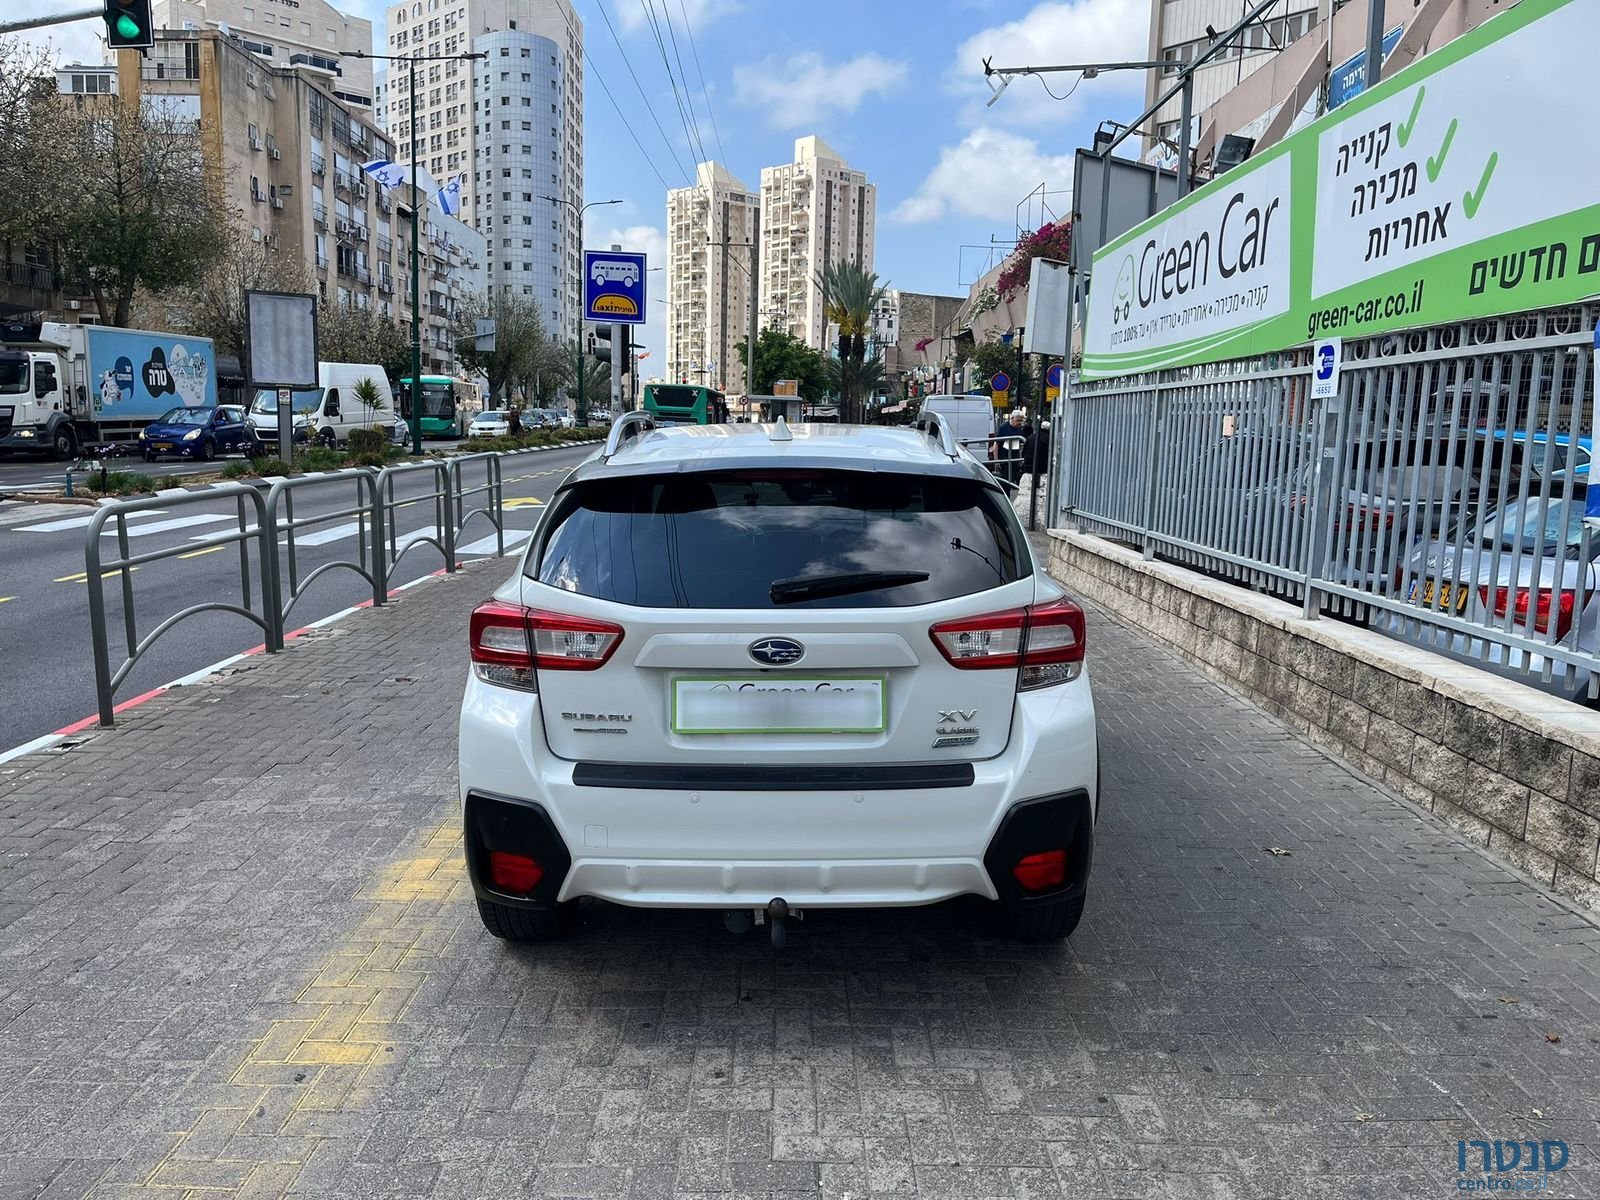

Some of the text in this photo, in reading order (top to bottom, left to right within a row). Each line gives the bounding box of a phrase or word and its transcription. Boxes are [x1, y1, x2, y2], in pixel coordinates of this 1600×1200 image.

[1336, 122, 1392, 177] קנייה
[1351, 162, 1417, 217] מכירה
[1365, 202, 1452, 262] אחריות
[1138, 192, 1279, 308] Green Car
[1468, 242, 1567, 296] חדשים
[1214, 294, 1239, 317] מכירה
[1247, 285, 1269, 311] קניה
[1308, 279, 1424, 339] green-car.co.il
[1182, 303, 1208, 325] אחריות
[1123, 326, 1138, 342] 100%
[149, 369, 167, 386] טרה
[561, 711, 632, 721] SUBARU
[938, 709, 978, 723] XV
